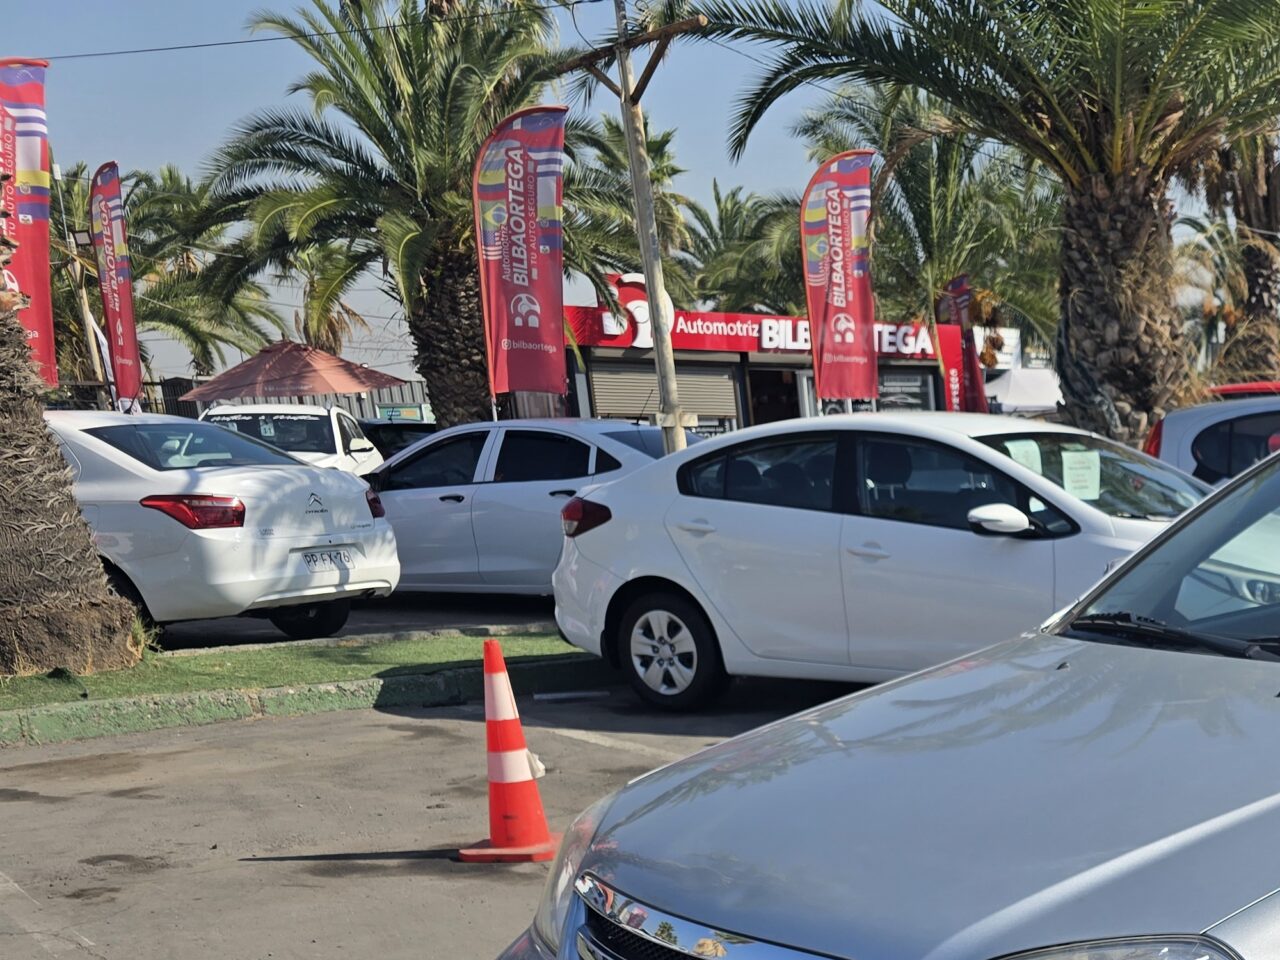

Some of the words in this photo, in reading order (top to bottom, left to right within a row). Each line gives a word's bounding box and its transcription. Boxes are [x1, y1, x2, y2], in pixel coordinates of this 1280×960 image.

[508, 145, 529, 287] BILBAORTEGA
[527, 175, 536, 219] SEGURO
[501, 225, 510, 282] Automotriz
[529, 220, 537, 252] AUTO
[828, 189, 847, 308] BILBAORTEGA
[530, 253, 538, 265] TU
[676, 315, 760, 338] Automotriz
[512, 339, 557, 353] bilbaortega
